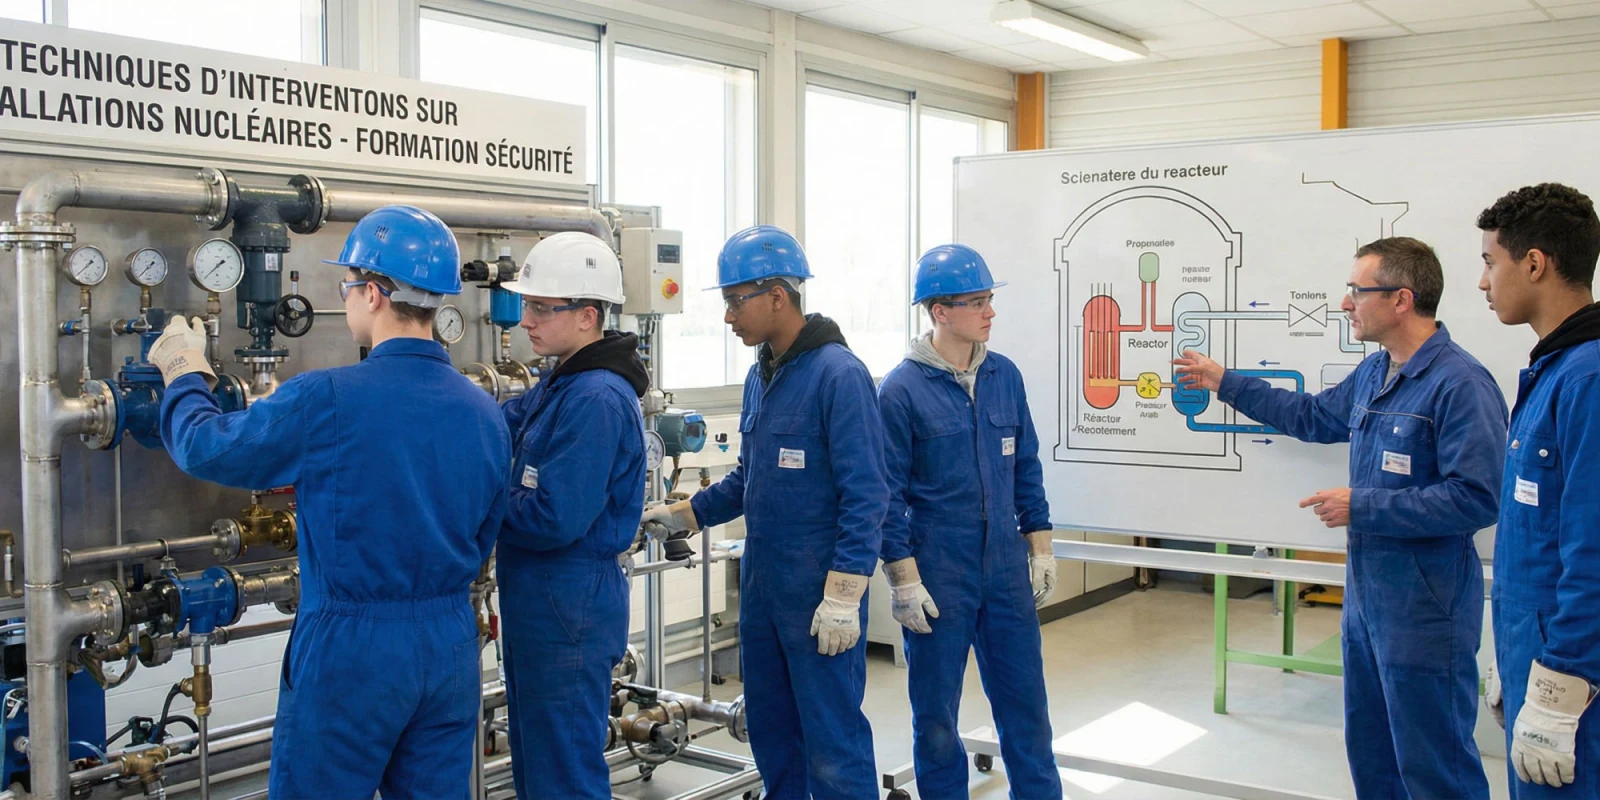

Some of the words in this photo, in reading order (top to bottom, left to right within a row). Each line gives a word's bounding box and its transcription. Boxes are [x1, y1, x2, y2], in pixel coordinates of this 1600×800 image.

[0, 39, 191, 93] TECHNIQUES
[416, 97, 458, 126] SUR
[0, 85, 164, 132] ALLATIONS
[175, 106, 332, 150] NUCLÉAIRES
[356, 127, 478, 165] FORMATION
[485, 138, 573, 174] SÉCURITÉ
[1060, 168, 1136, 185] Scienatere
[1140, 167, 1159, 180] du
[1164, 164, 1228, 178] reacteur
[1127, 338, 1169, 349] Reactor
